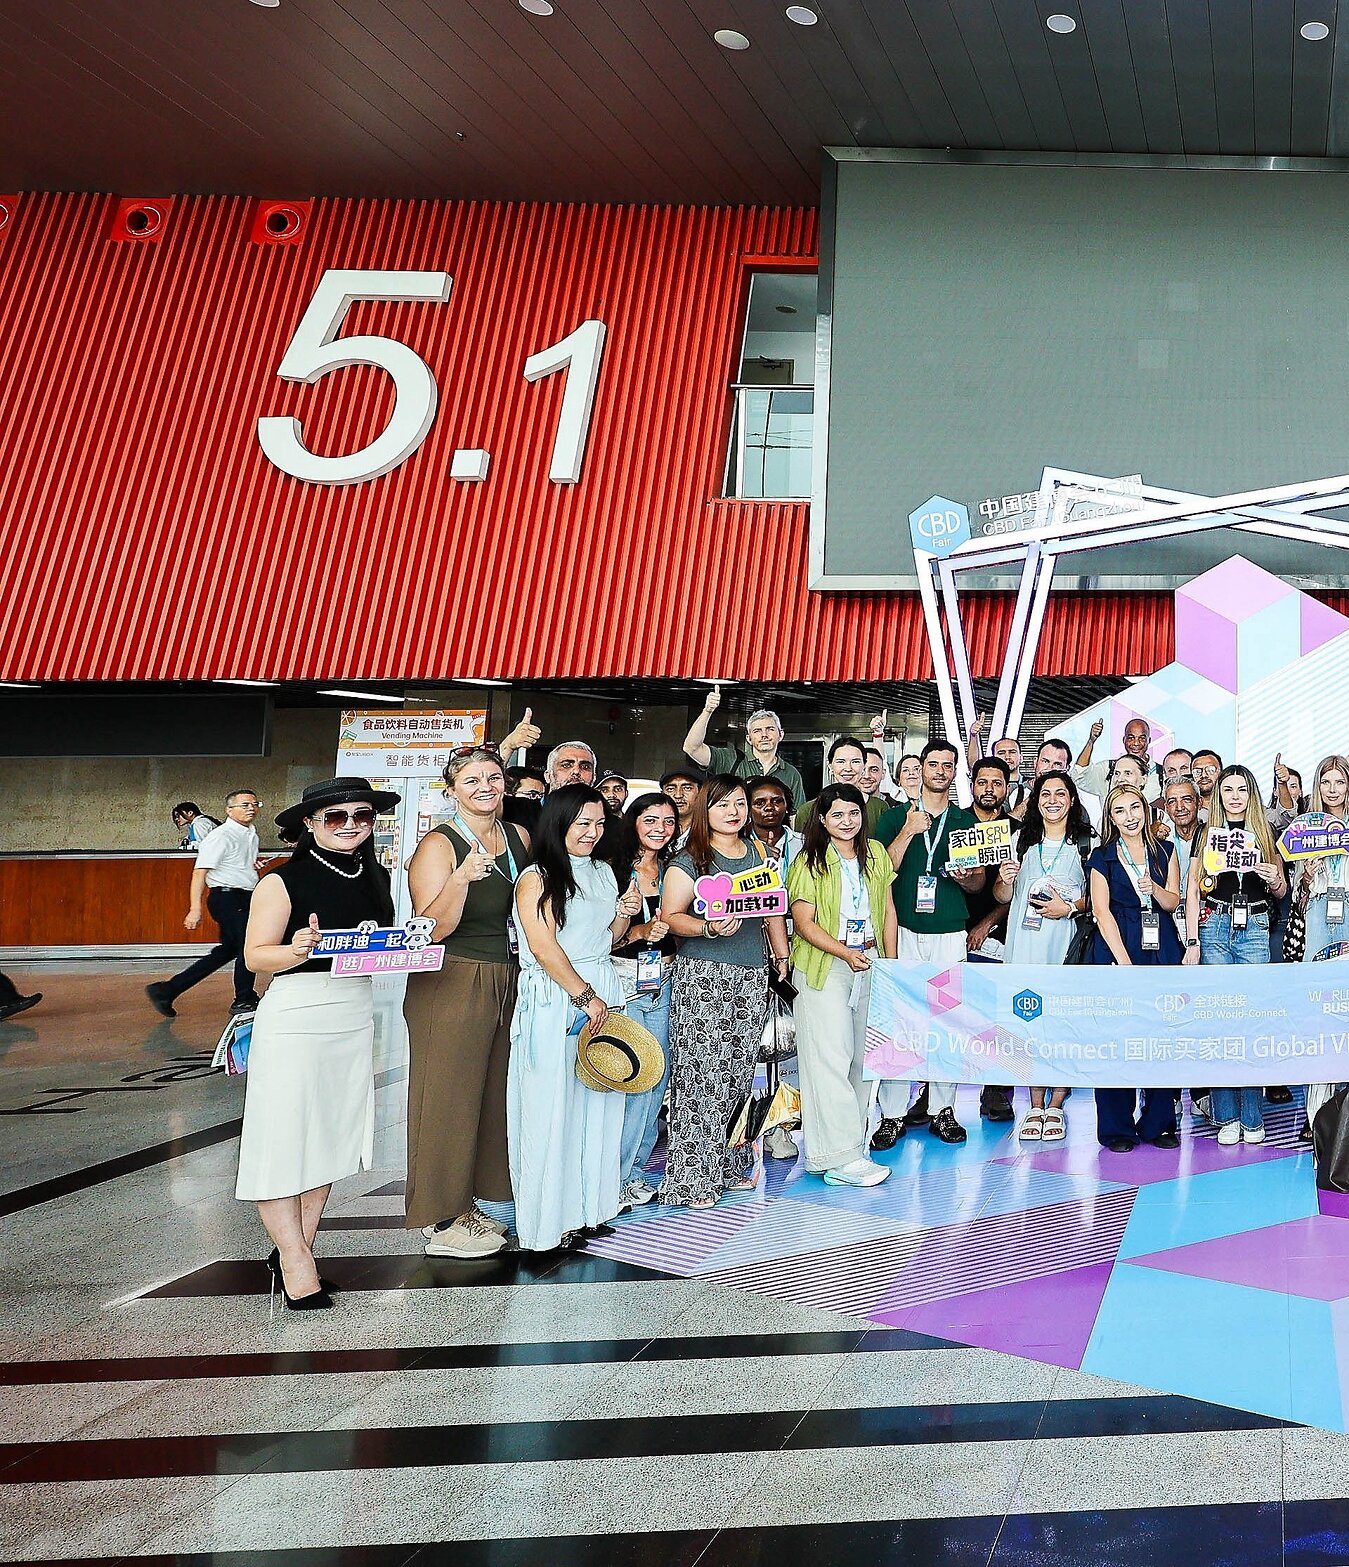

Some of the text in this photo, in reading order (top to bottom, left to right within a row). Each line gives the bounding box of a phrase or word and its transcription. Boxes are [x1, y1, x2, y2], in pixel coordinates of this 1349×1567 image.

[257, 269, 606, 486] 5.1
[917, 509, 961, 538] CBD
[982, 519, 1017, 536] CBD
[932, 538, 951, 548] Fair
[362, 718, 464, 730] 食品饮料自动售货机
[381, 732, 411, 740] Vending
[951, 829, 985, 848] 家的
[1211, 831, 1245, 852] 指尖
[978, 844, 1012, 863] 瞬间
[1226, 851, 1257, 868] 链动
[739, 872, 772, 892] 心动
[725, 895, 780, 913] 加载中
[318, 933, 403, 951] 和胖迪一起
[341, 952, 439, 970] 逛广州建博会
[1017, 996, 1039, 1010] CBD
[1154, 993, 1186, 1013] CBD
[1194, 1008, 1288, 1019] CBD World-Connect
[893, 1031, 941, 1052] CBD
[949, 1034, 1118, 1060] World-Connect
[1124, 1036, 1246, 1062] 国际买家团
[1253, 1033, 1324, 1058] Global
